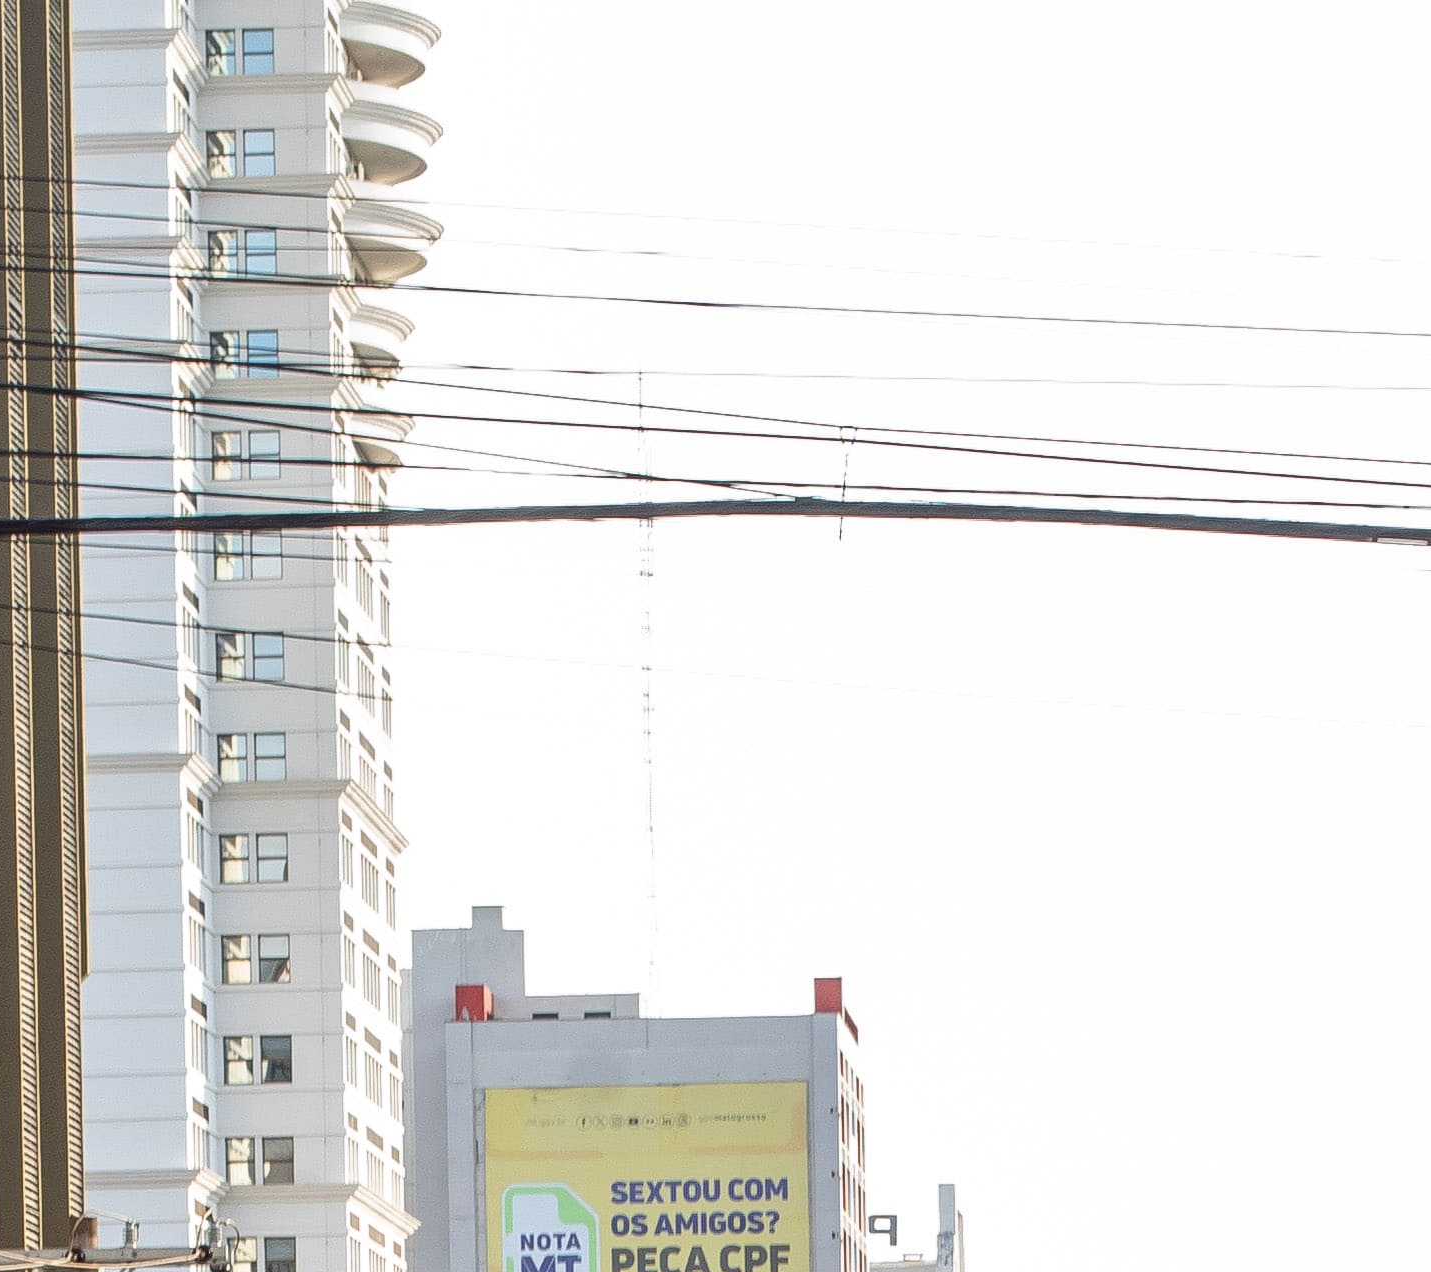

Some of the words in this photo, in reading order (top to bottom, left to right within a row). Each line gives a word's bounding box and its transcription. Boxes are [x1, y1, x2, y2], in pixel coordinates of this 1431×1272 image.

[611, 1179, 721, 1204] SEXTOU
[727, 1177, 789, 1201] COM
[611, 1214, 649, 1236] OS
[654, 1211, 781, 1236] AMIGOS?
[520, 1233, 582, 1251] NOTA
